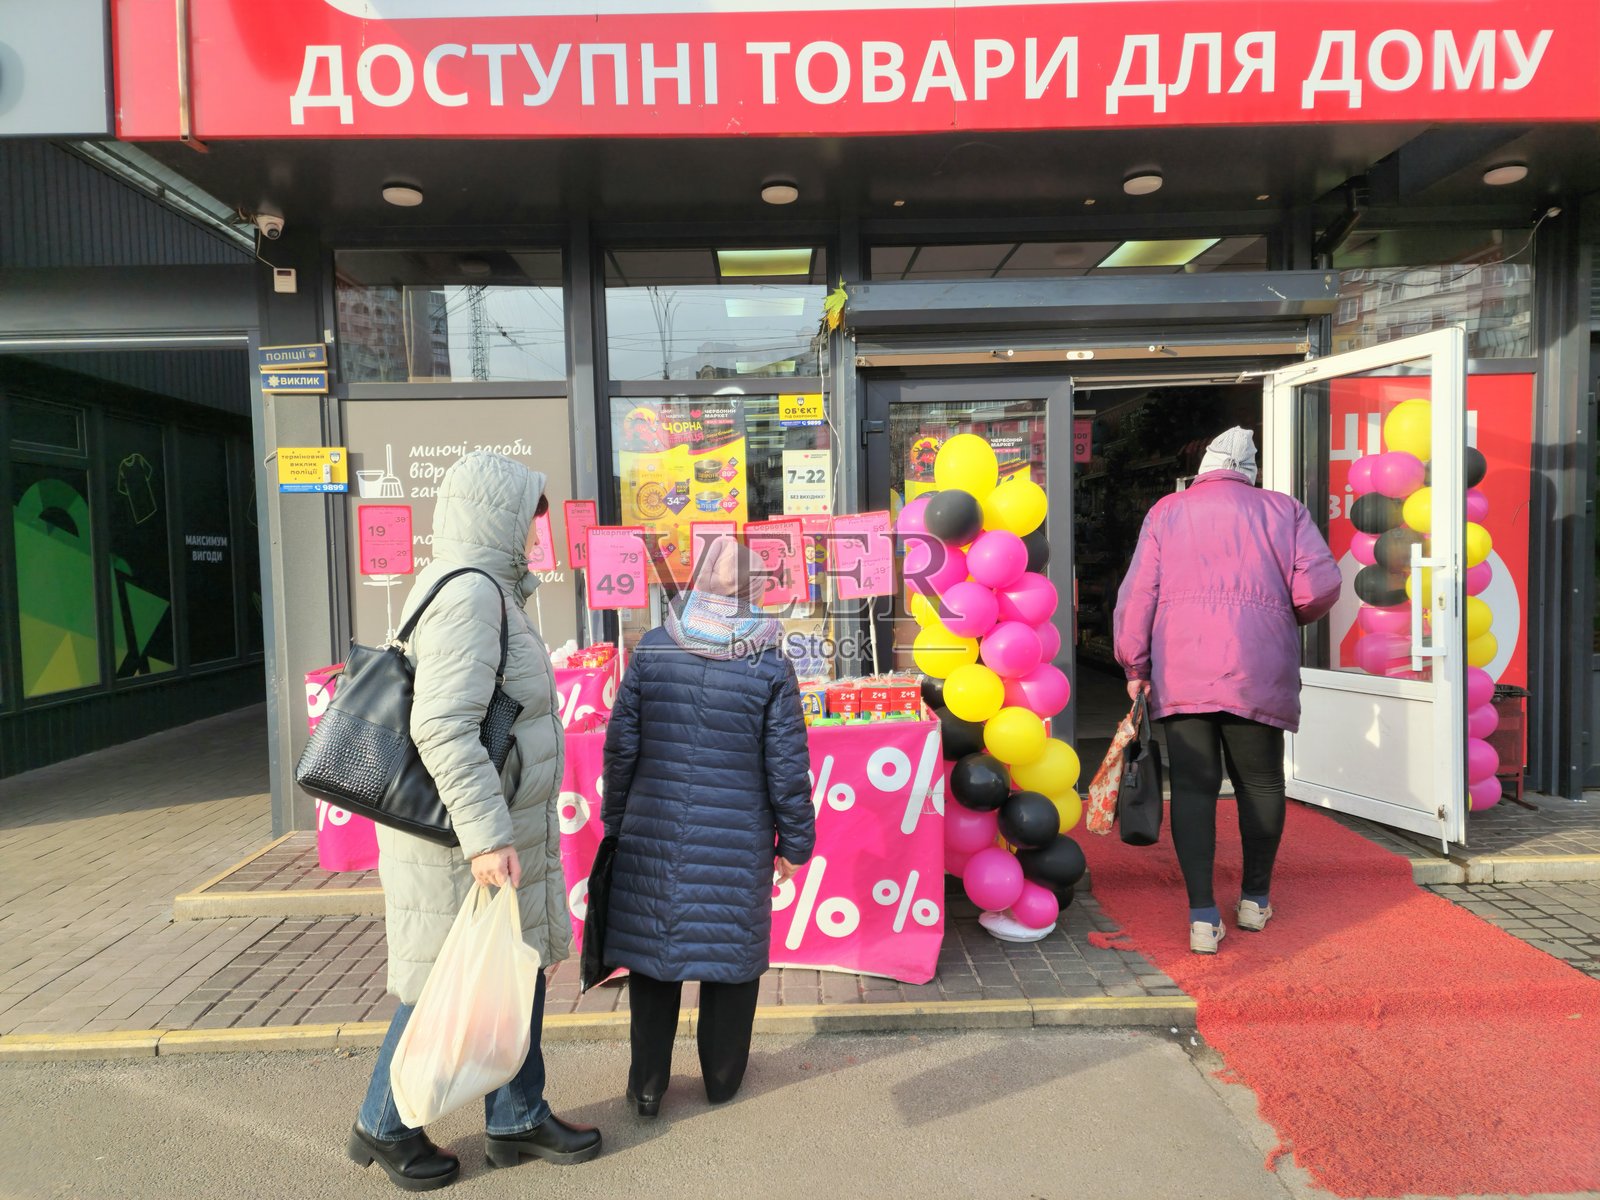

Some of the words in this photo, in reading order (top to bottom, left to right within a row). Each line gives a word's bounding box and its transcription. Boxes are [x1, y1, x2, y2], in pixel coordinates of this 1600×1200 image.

[289, 42, 719, 126] ДОСТУПНІ
[745, 35, 1079, 105] ТОВАРИ
[1105, 30, 1277, 115] ДЛЯ
[1301, 28, 1555, 110] ДОМУ
[265, 350, 306, 361] ПОЛІЦІЇ
[280, 377, 320, 385] ВИКЛИК
[661, 421, 703, 434] ЧОРНА
[408, 440, 468, 458] миючі
[787, 469, 826, 484] 7-22
[368, 525, 386, 537] 19
[185, 535, 228, 546] МАКСИМУМ
[192, 551, 223, 563] ВИГОДИ
[370, 557, 388, 569] 19
[619, 552, 639, 564] 79
[596, 573, 635, 595] 49
